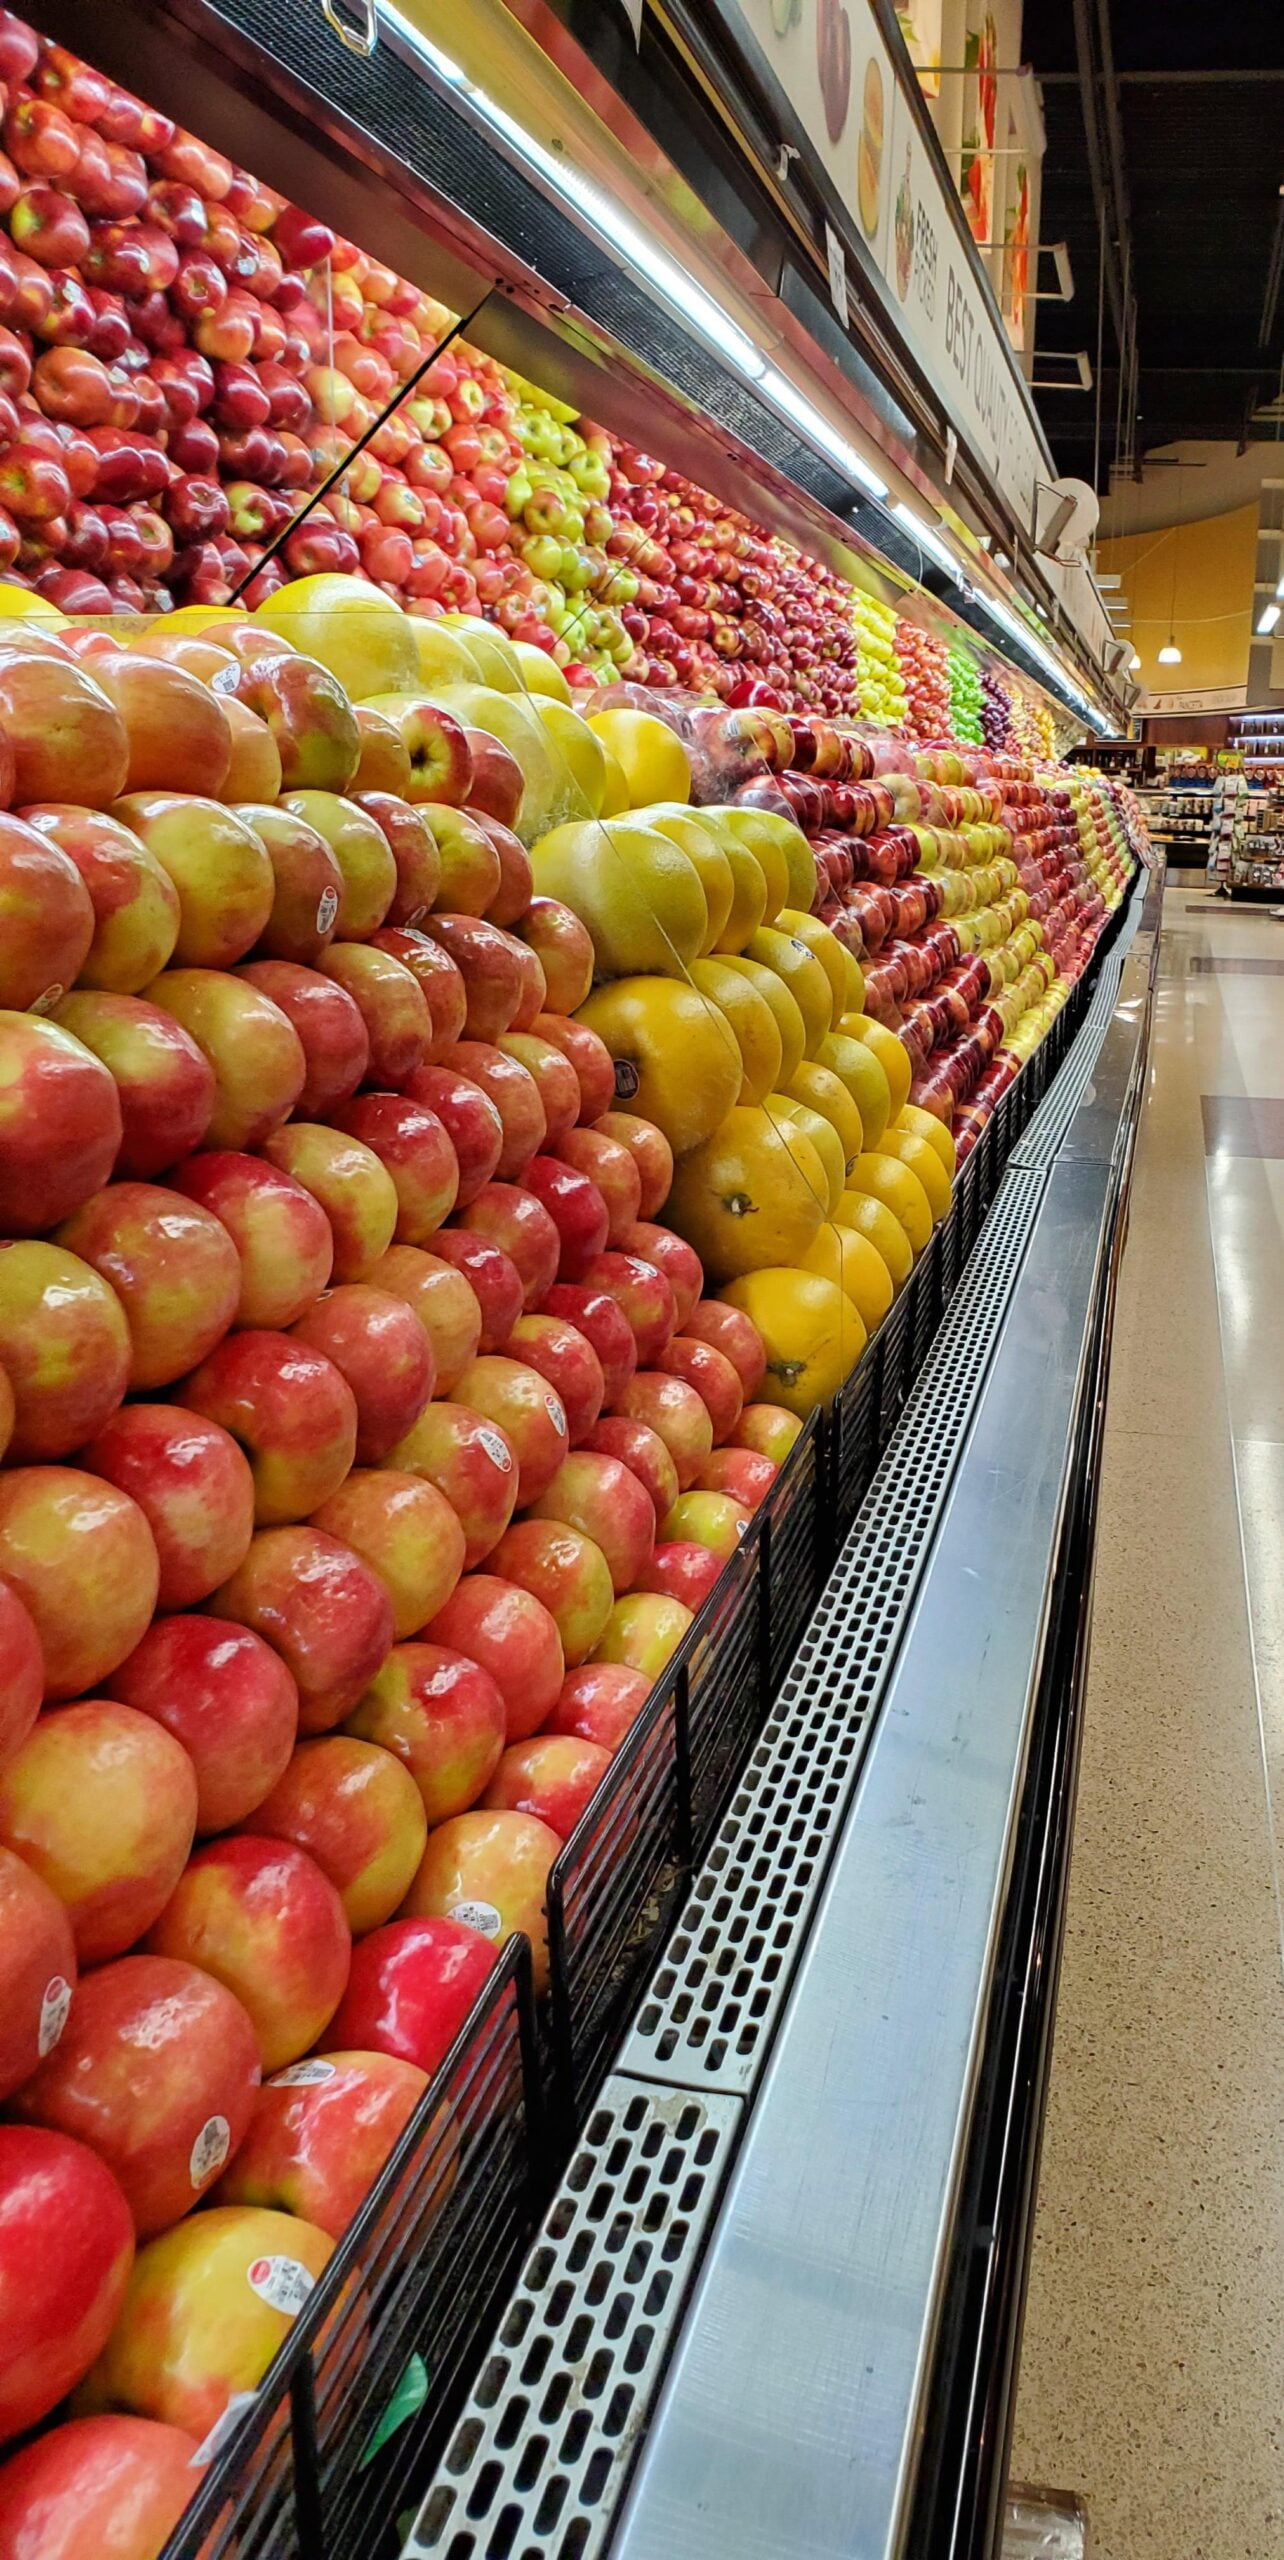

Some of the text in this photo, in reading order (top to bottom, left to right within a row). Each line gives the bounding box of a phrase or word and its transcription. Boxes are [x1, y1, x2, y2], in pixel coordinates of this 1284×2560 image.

[916, 199, 938, 282] FRESH
[945, 264, 1010, 448] BEST QUALITY
